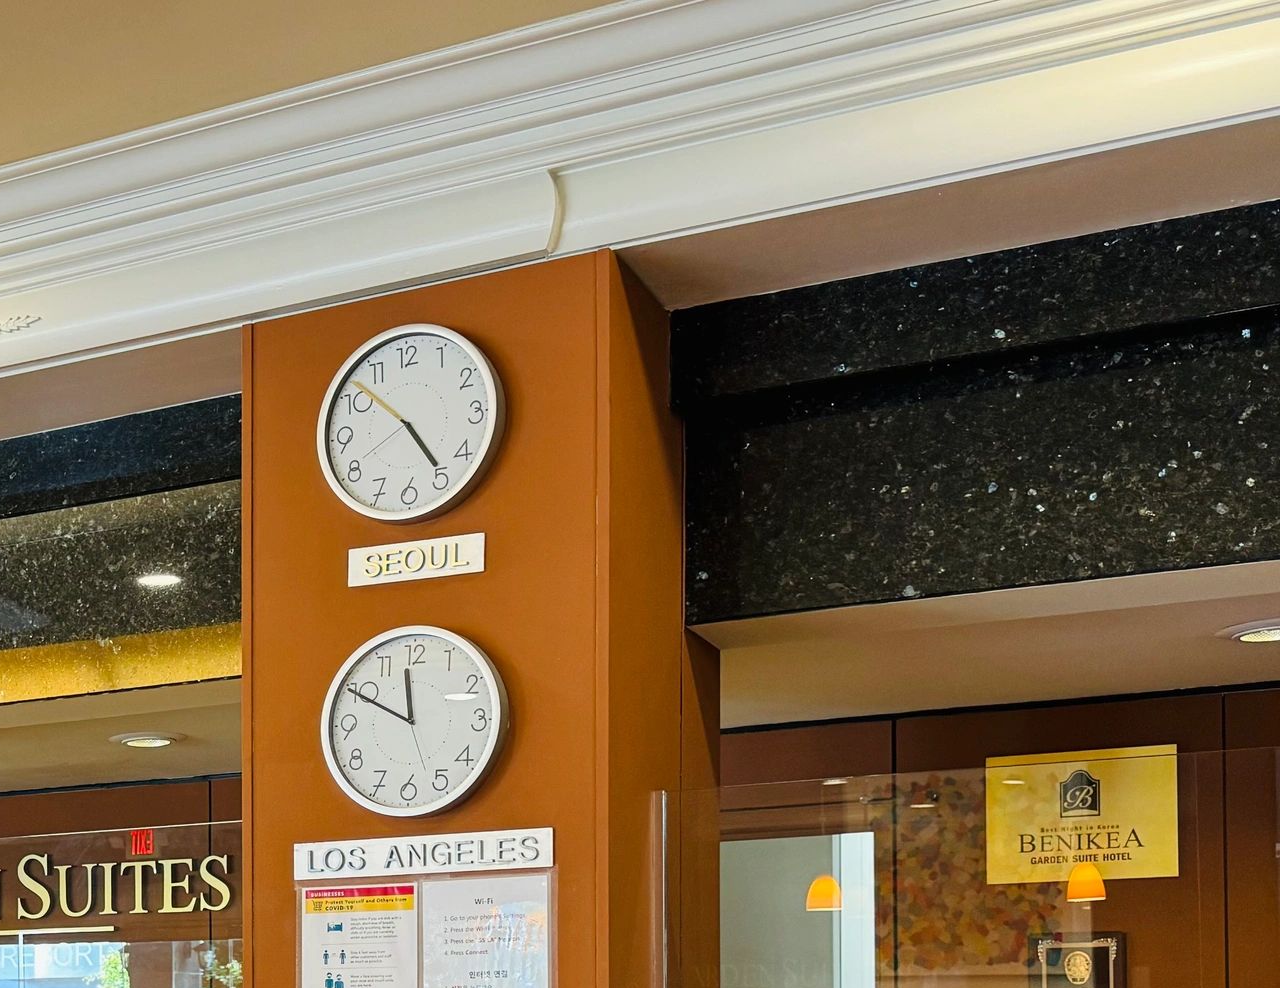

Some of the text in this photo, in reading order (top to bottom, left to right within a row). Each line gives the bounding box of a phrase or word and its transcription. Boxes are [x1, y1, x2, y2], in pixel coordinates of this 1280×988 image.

[396, 346, 418, 368] 12
[436, 346, 446, 368] 1
[369, 362, 384, 384] 11
[460, 368, 474, 390] 2
[344, 390, 373, 415] 10
[468, 400, 484, 424] 3
[337, 426, 354, 454] 9
[454, 440, 472, 461] 4
[347, 460, 362, 482] 8
[432, 467, 449, 490] 5
[372, 477, 387, 506] 7
[400, 476, 418, 505] 6
[363, 542, 470, 579] SEOUL
[376, 656, 392, 677] 11
[404, 644, 426, 666] 12
[444, 649, 454, 672] 1
[350, 682, 380, 704] 10
[465, 674, 480, 694] 2
[340, 714, 358, 740] 9
[470, 708, 488, 732] 3
[348, 748, 364, 770] 8
[454, 744, 474, 766] 4
[372, 770, 387, 798] 7
[400, 774, 418, 801] 6
[432, 769, 449, 792] 5
[1018, 828, 1145, 854] BENIKEA
[306, 836, 540, 873] LOS ANGELES
[1030, 852, 1132, 865] GARDEN SUITE HOTEL
[17, 853, 231, 920] SUITES
